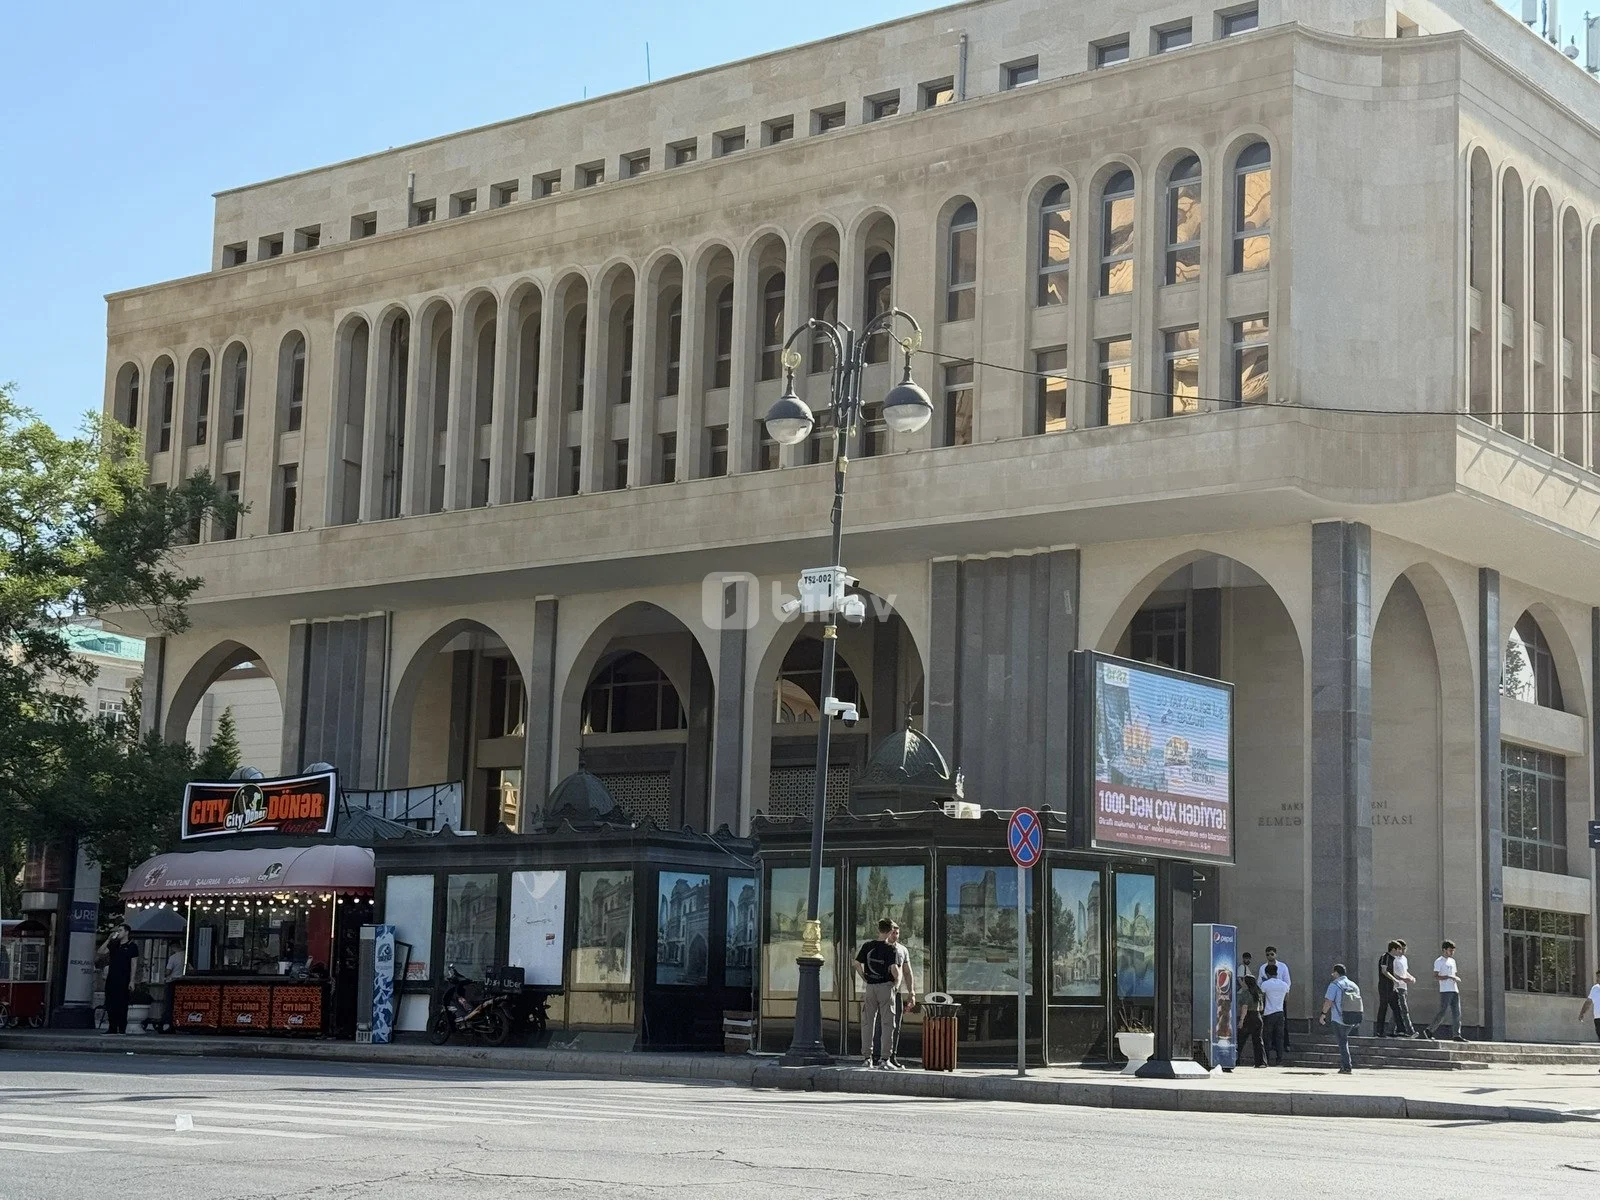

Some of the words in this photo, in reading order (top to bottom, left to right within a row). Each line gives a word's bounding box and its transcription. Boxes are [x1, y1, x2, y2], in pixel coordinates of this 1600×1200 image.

[804, 573, 832, 585] TS2-002
[190, 799, 228, 825] CITY
[267, 788, 325, 820] DÖNƏR
[1098, 789, 1154, 819] 1000-DƏN
[1155, 798, 1177, 827] ÇOX
[1178, 801, 1227, 830] HƏDİYYƏ!
[226, 813, 244, 830] City
[1258, 816, 1302, 827] ELMLƏ
[1371, 813, 1413, 825] İYASI
[503, 979, 522, 988] Uber
